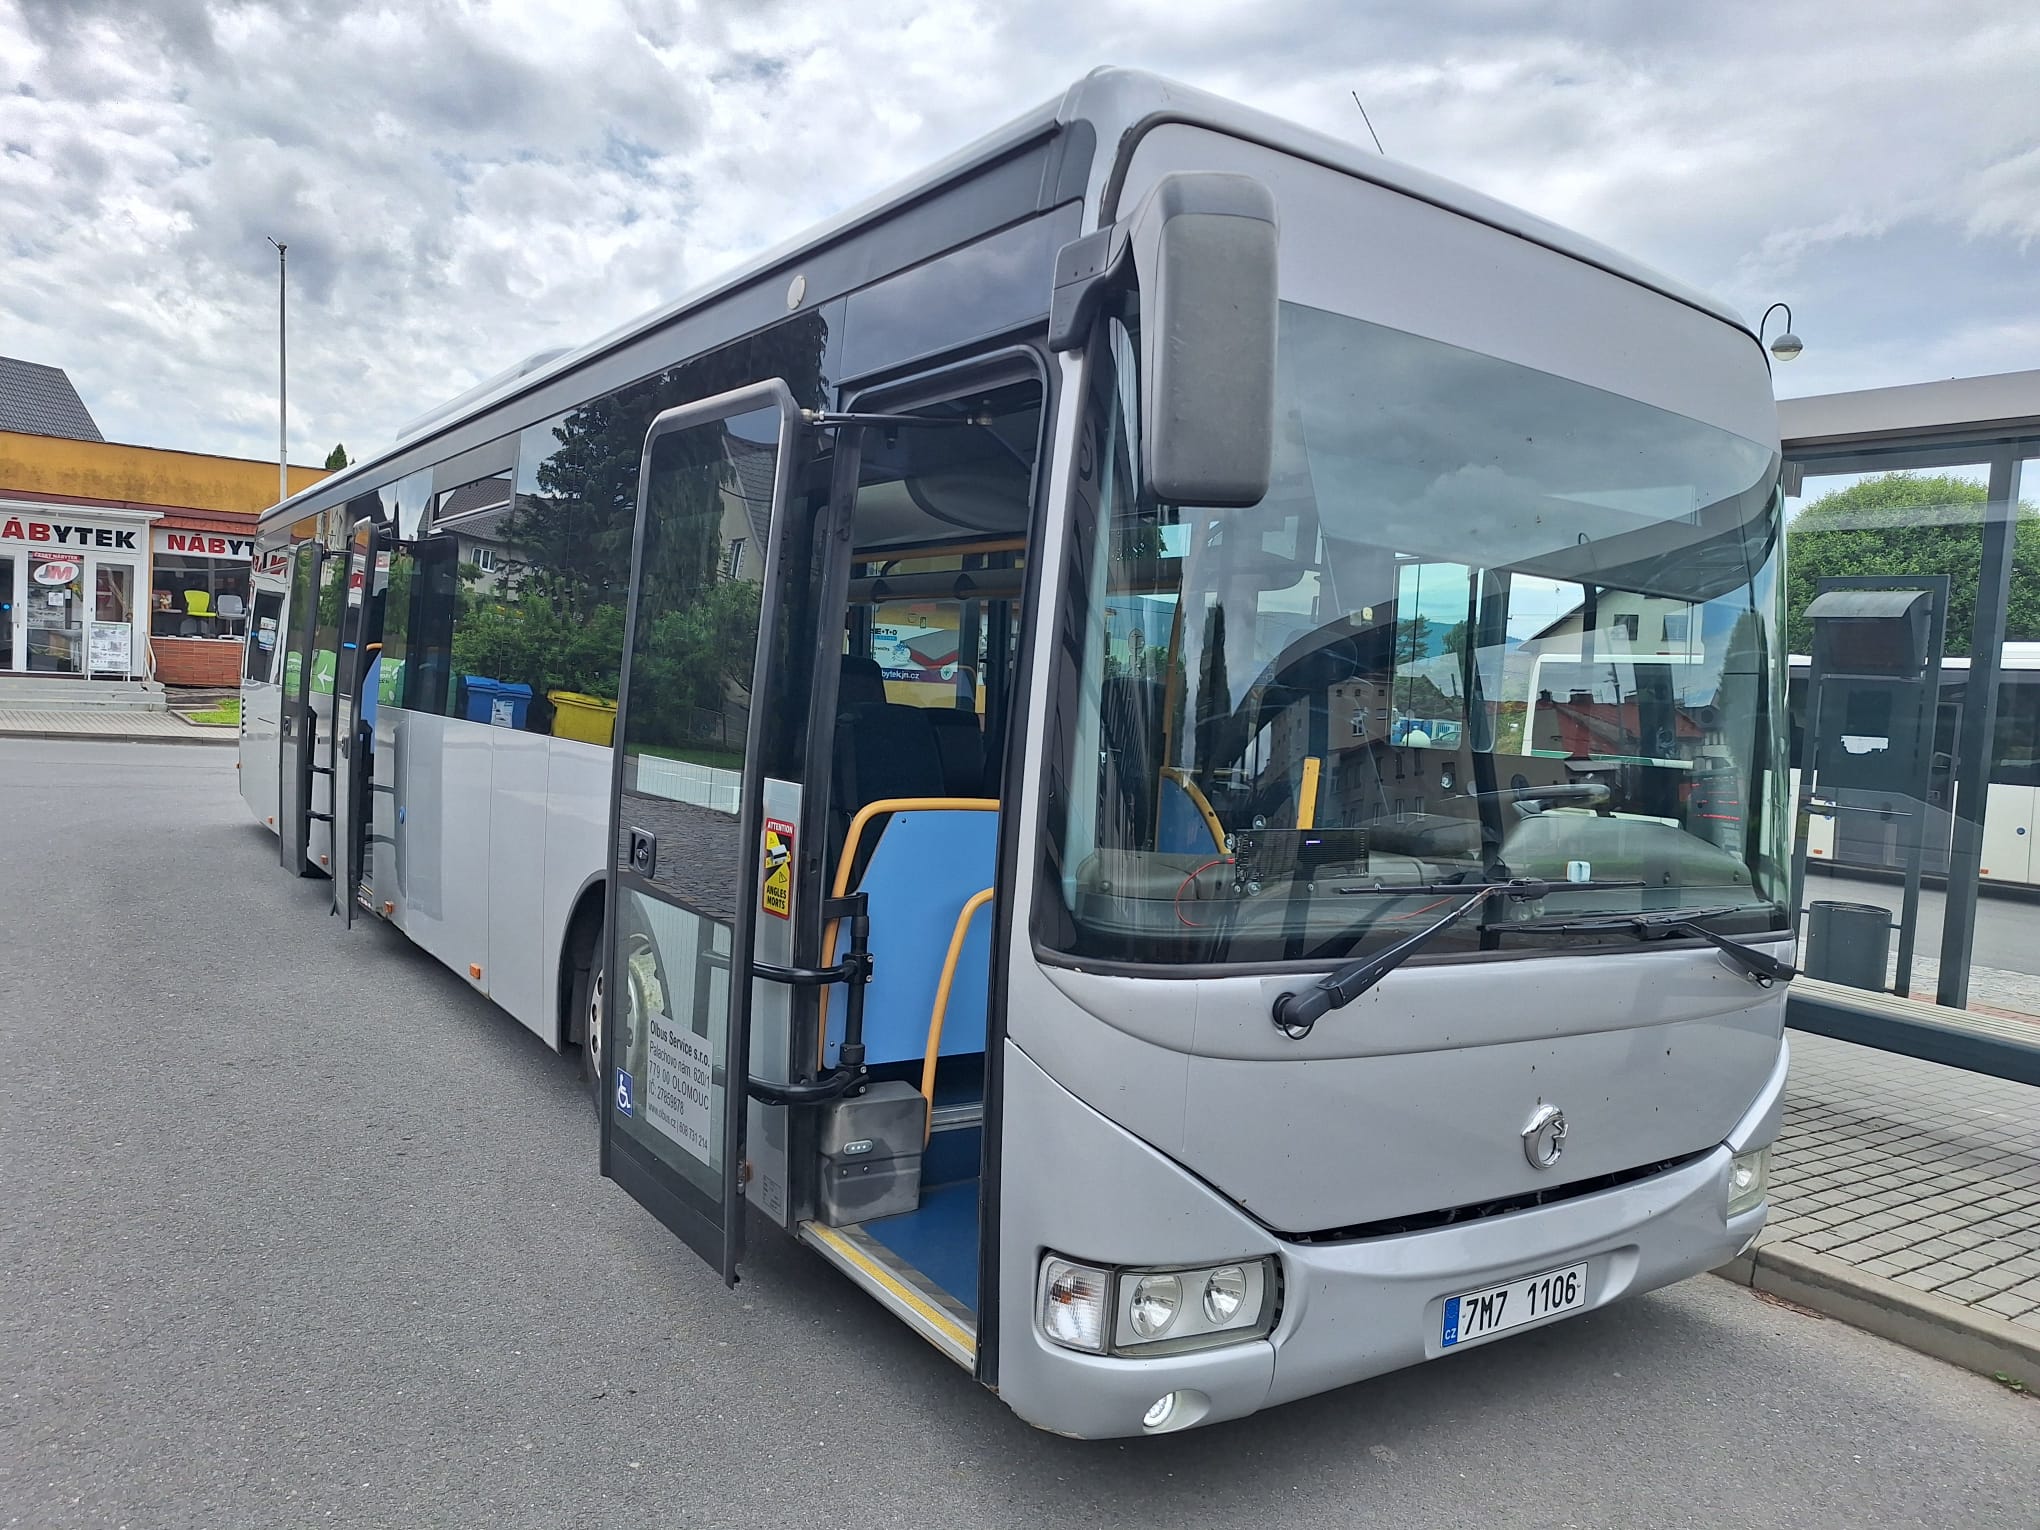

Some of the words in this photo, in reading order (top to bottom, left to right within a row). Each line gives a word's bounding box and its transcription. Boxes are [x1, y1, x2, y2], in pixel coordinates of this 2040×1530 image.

[1, 517, 136, 549] ÁBYTEK
[767, 821, 793, 834] ATTENTION
[767, 885, 786, 900] ANGLES
[767, 896, 785, 909] MORTS
[651, 1020, 667, 1042] Olbus
[669, 1030, 692, 1056] Service
[694, 1048, 710, 1068] s.r.o.
[650, 1060, 660, 1079] 779
[672, 1075, 709, 1110] OLOMOUC
[694, 1067, 710, 1089] 620/1
[1465, 1290, 1508, 1335] 7M7
[1527, 1271, 1577, 1316] 1106
[1444, 1327, 1457, 1340] CZ
